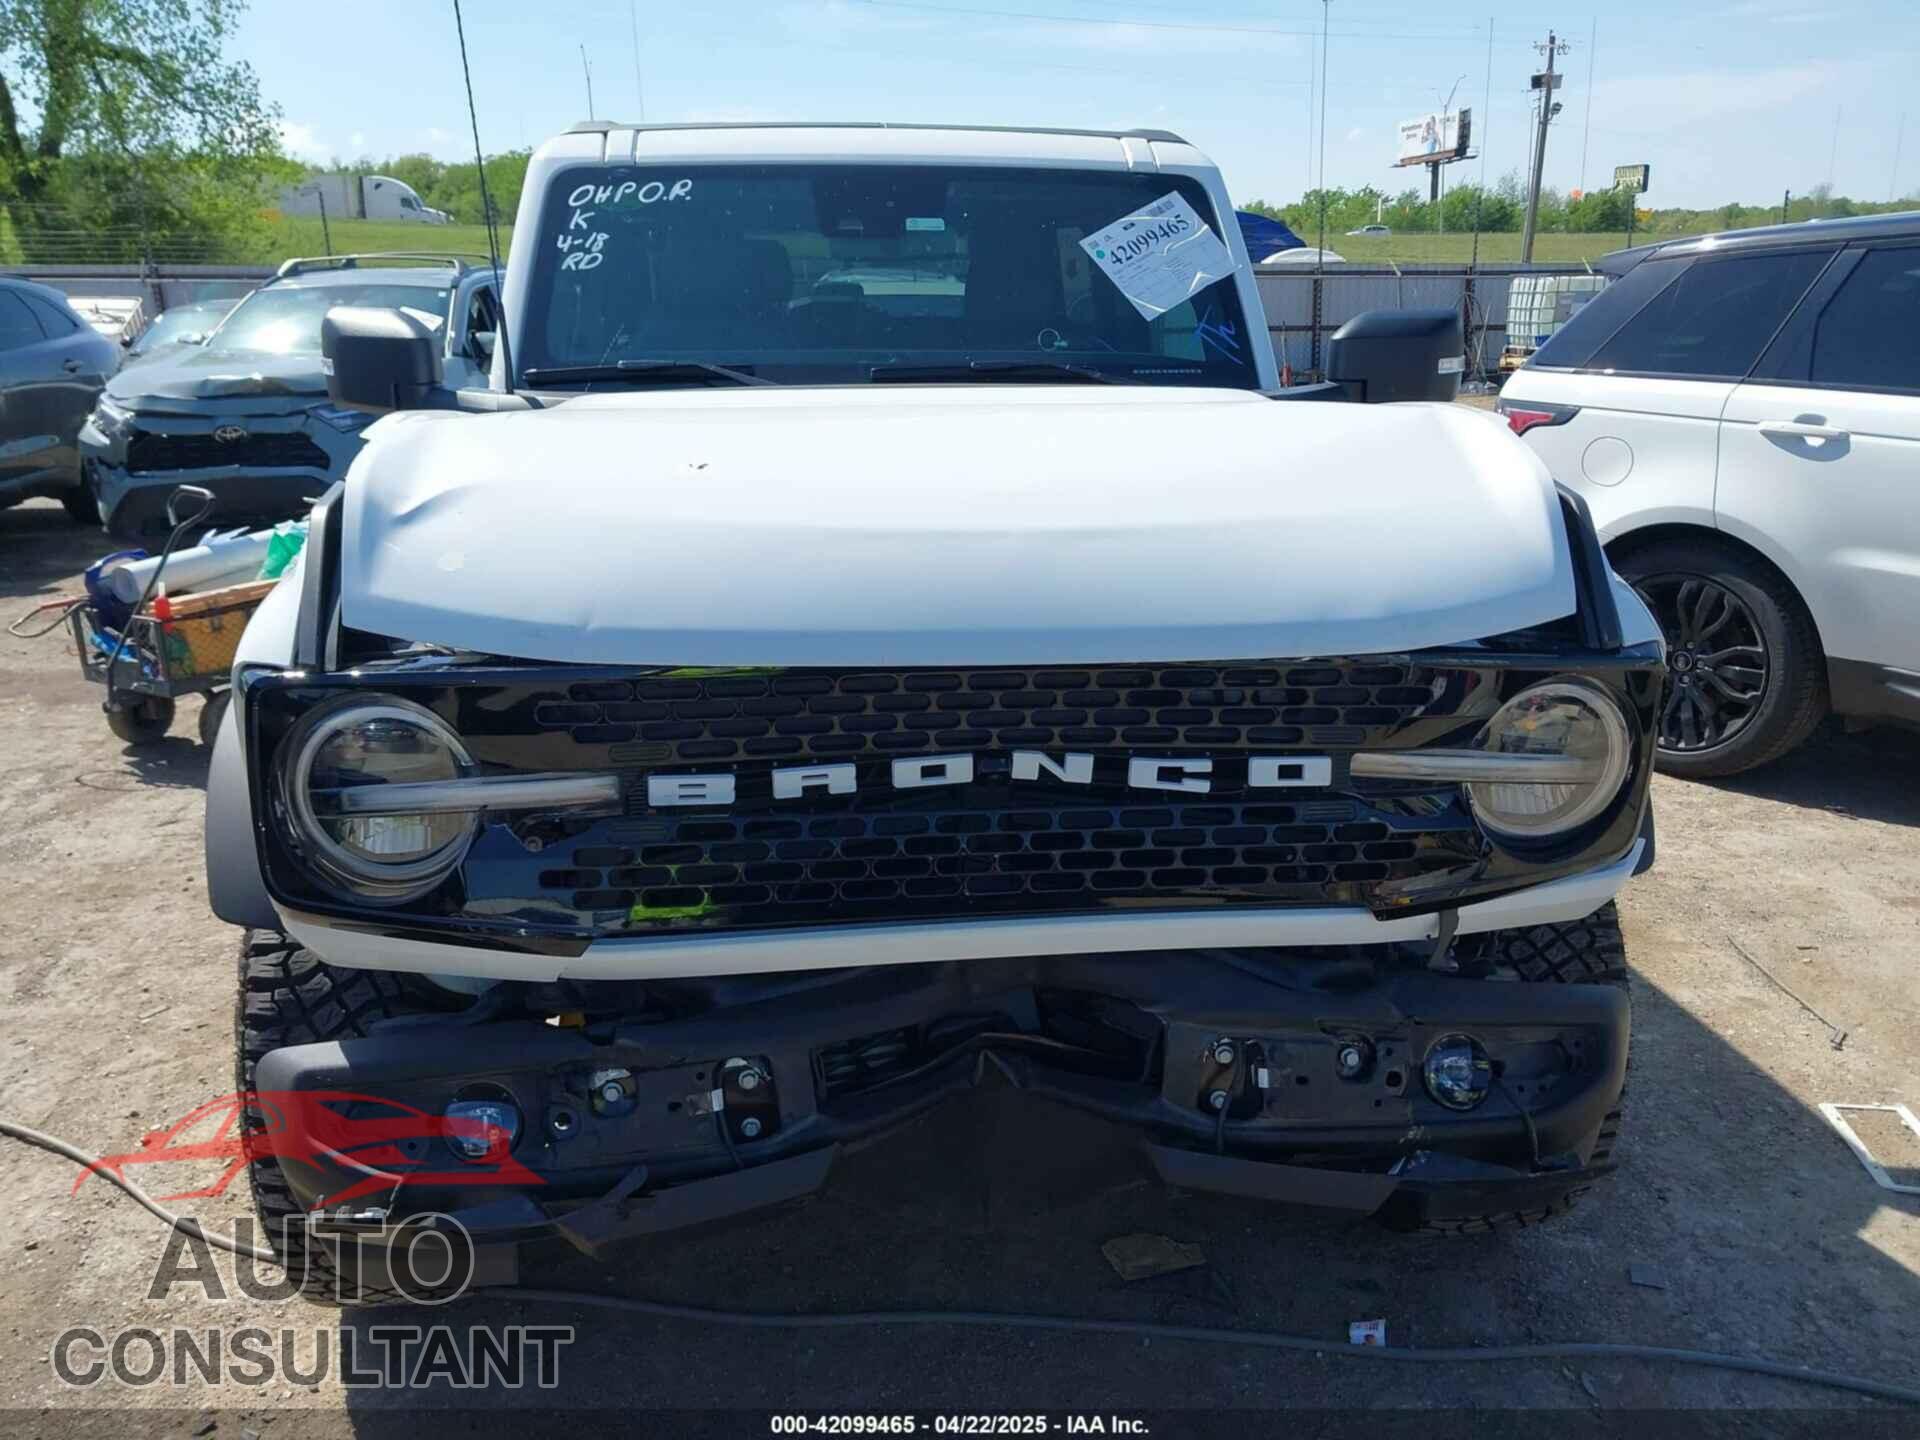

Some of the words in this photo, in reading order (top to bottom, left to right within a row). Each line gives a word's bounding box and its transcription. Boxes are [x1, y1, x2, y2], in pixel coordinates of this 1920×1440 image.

[569, 208, 596, 230] K
[556, 231, 611, 253] 4-18
[1109, 214, 1190, 265] 42099465
[560, 252, 604, 271] RD
[647, 752, 1332, 807] BRONCO
